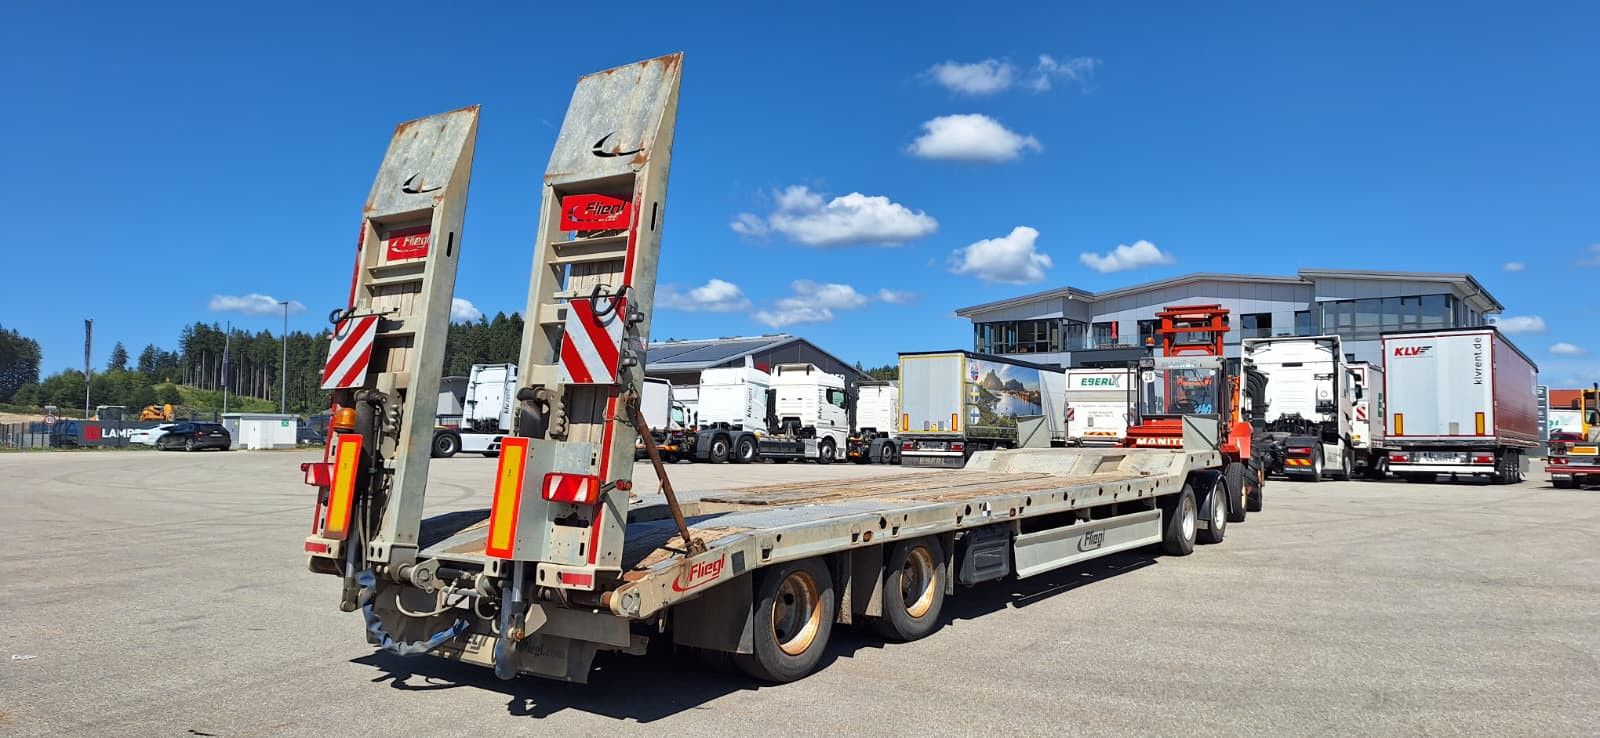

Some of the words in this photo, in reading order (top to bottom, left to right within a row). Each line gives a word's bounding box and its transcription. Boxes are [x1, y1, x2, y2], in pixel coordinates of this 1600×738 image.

[584, 201, 627, 218] Fliegl
[1394, 346, 1421, 356] KLV
[1473, 337, 1484, 385] klvrent.de
[1084, 528, 1106, 548] Fliegl
[687, 553, 725, 582] Fliegl
